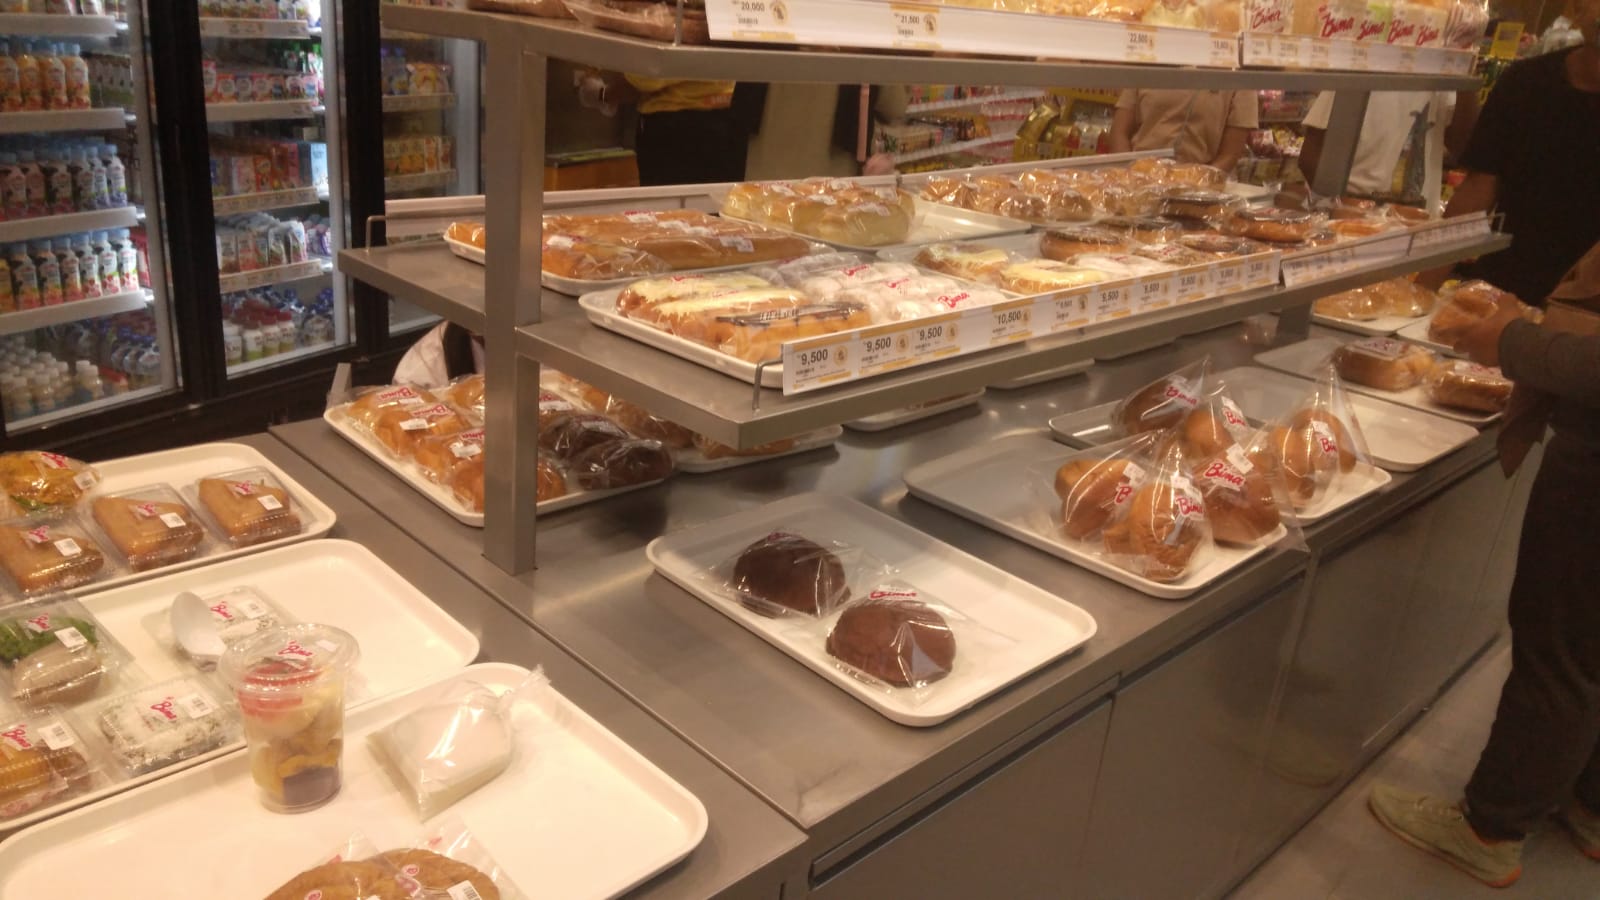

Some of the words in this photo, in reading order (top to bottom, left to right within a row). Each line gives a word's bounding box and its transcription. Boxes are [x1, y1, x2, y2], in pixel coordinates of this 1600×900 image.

[997, 310, 1022, 325] 10,500
[919, 326, 943, 342] 9,500
[866, 336, 892, 353] 9,500
[801, 348, 829, 366] 9,500
[413, 404, 446, 416] Bima
[1204, 462, 1245, 486] Bima
